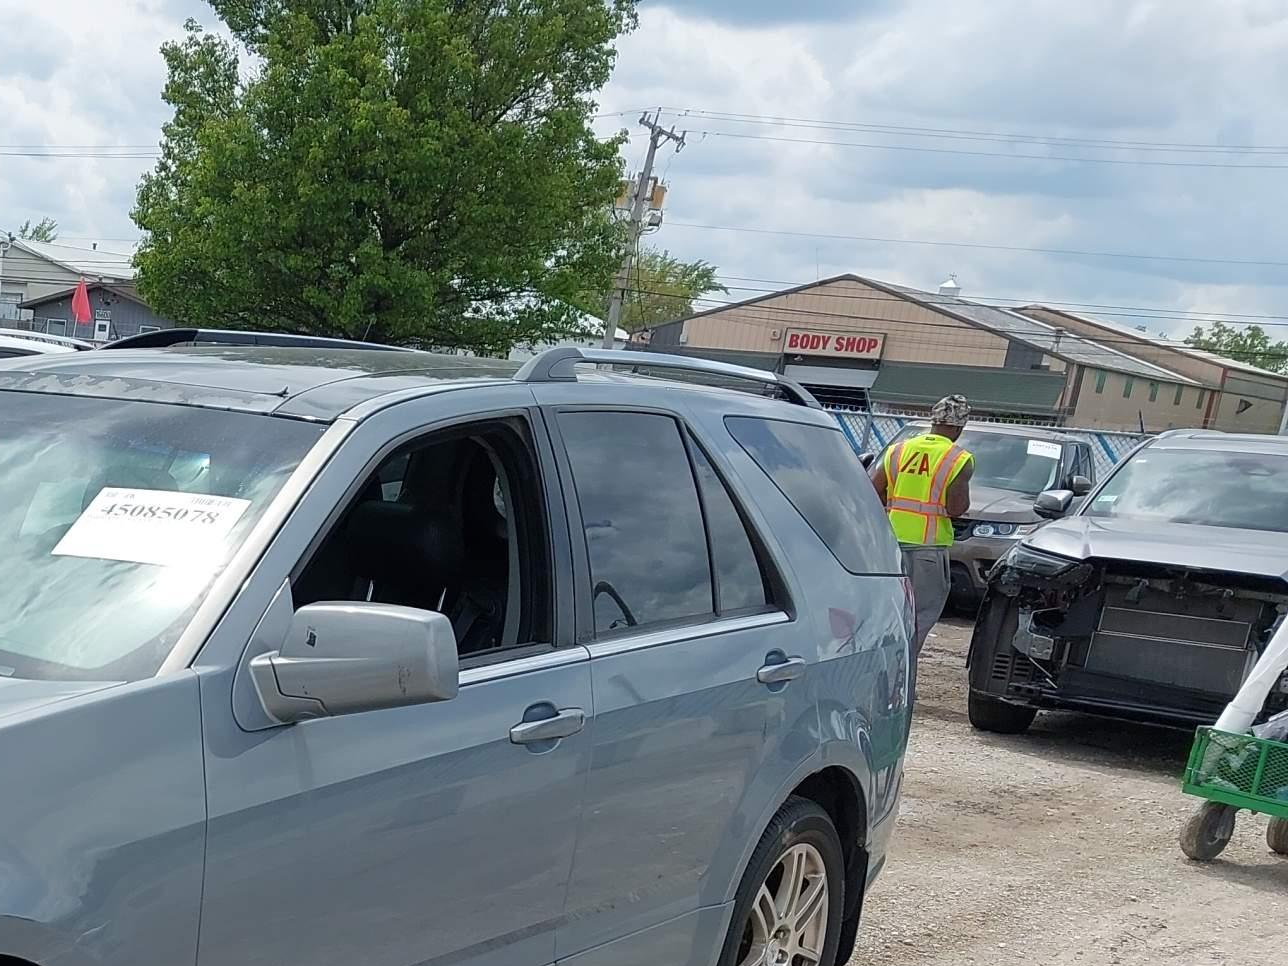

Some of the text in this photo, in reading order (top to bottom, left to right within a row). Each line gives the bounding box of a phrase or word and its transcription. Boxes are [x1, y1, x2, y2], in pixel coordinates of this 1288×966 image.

[788, 333, 879, 353] BODY SHOP
[100, 503, 220, 525] 45085078
